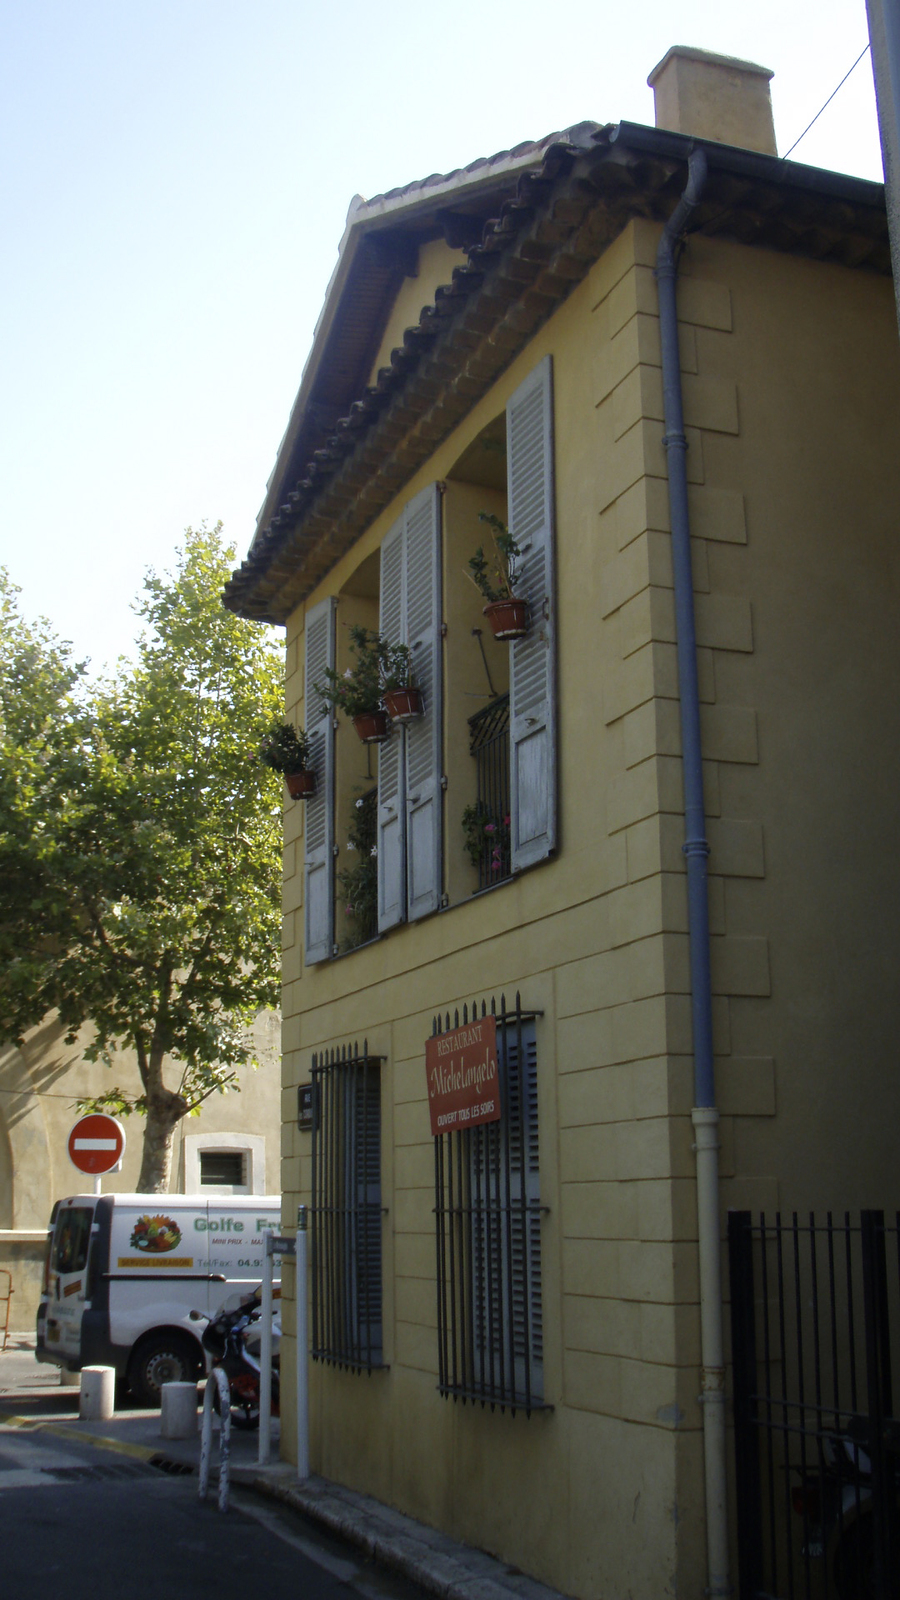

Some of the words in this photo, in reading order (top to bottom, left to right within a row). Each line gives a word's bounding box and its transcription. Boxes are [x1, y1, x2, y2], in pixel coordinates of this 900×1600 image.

[437, 1025, 482, 1057] RESTAURANT
[430, 1047, 496, 1098] Michelangelo
[437, 1111, 457, 1127] OUVERT
[458, 1108, 471, 1122] TOUS
[471, 1104, 480, 1118] LES
[480, 1100, 495, 1115] SOIRS
[194, 1217, 245, 1232] Golfe
